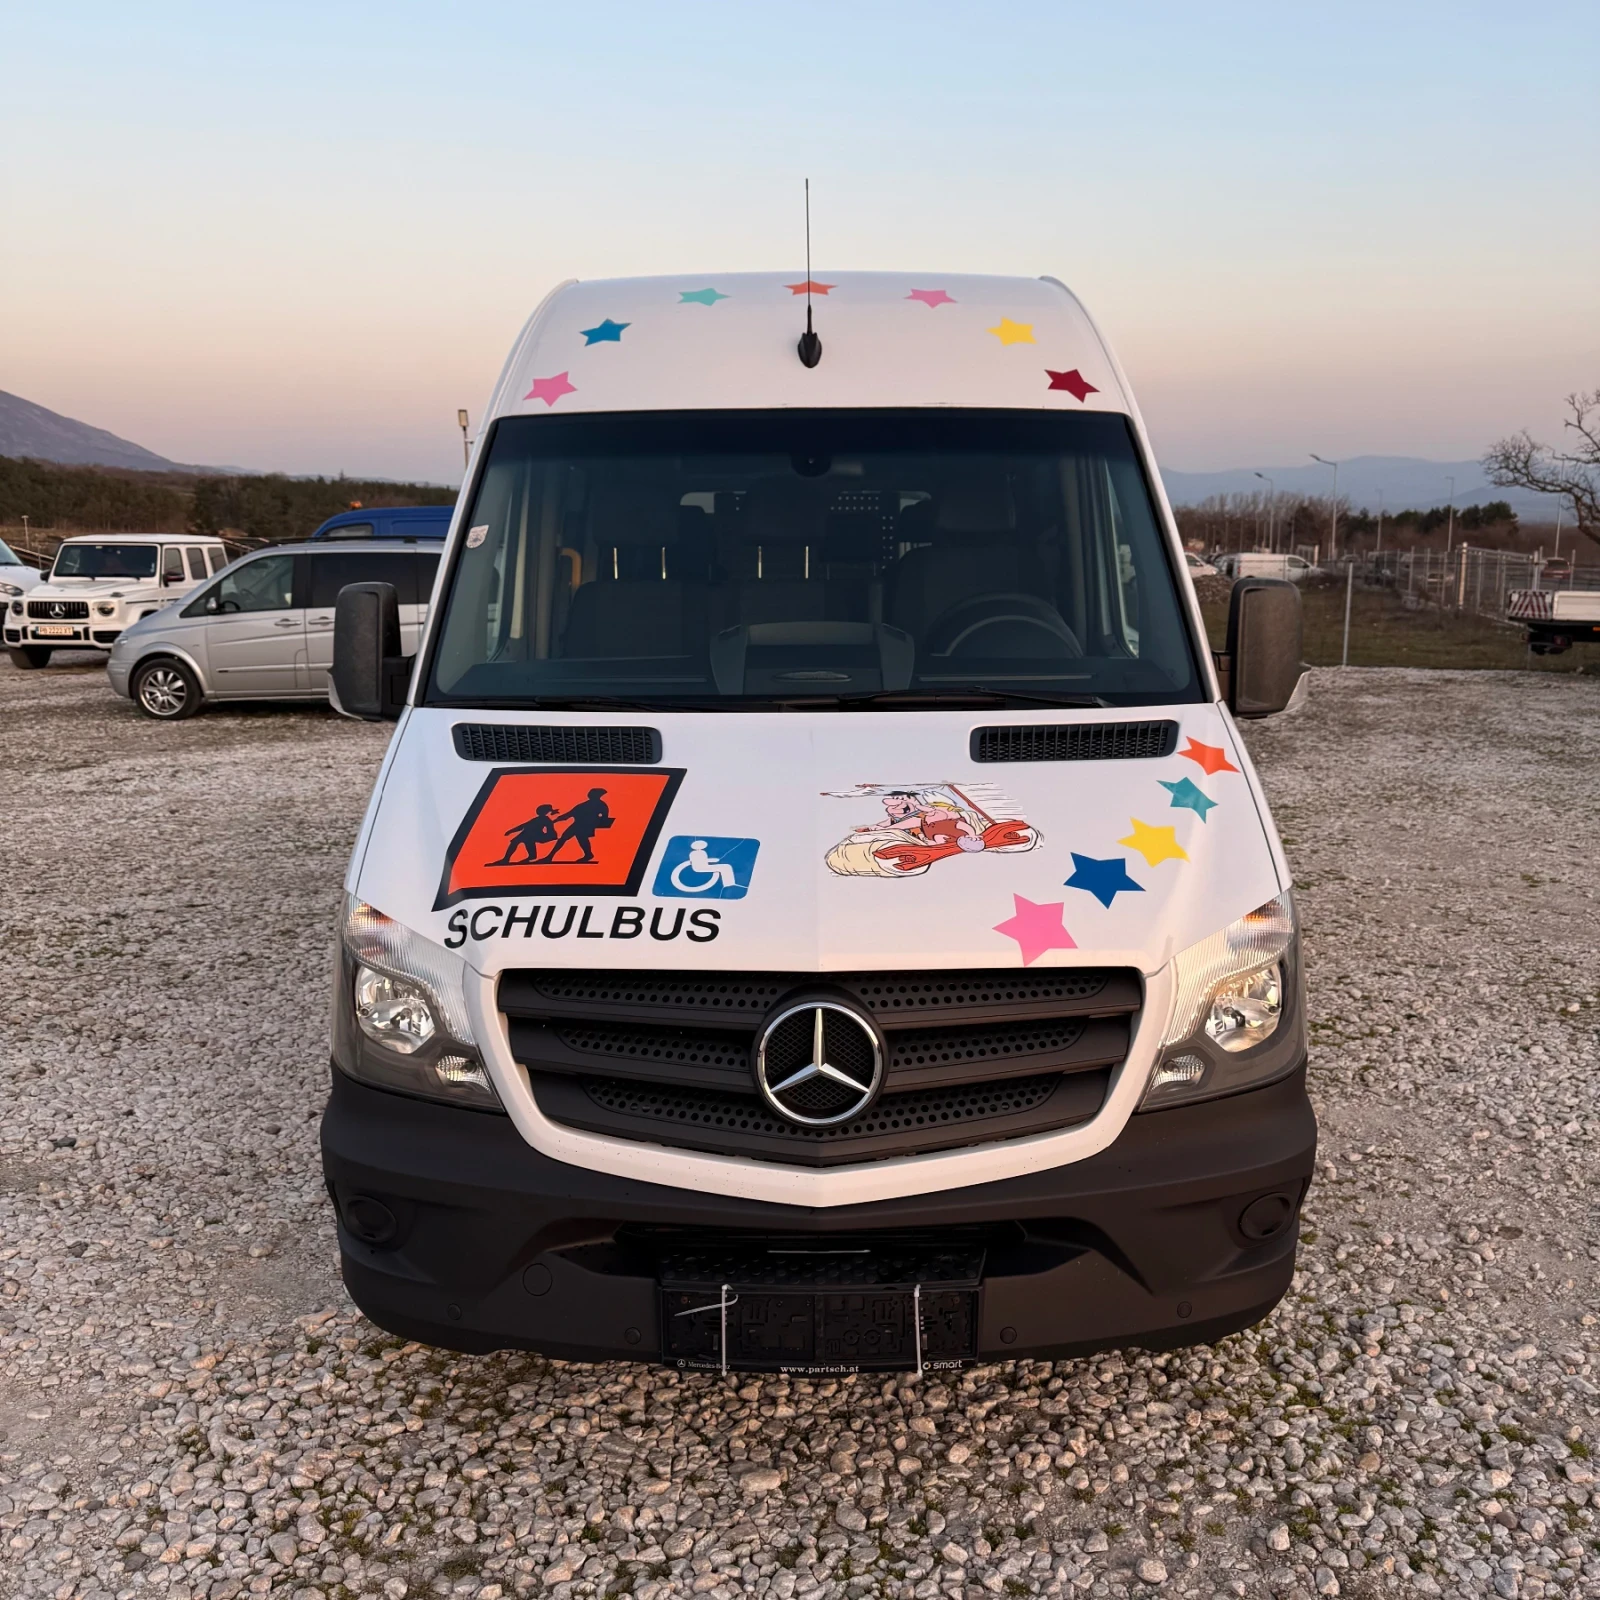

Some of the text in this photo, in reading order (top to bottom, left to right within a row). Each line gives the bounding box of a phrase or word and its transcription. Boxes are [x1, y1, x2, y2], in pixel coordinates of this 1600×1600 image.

[48, 626, 63, 634] 2222
[444, 905, 721, 948] SCHULBUS
[933, 1360, 962, 1369] smart
[780, 1365, 859, 1374] www.partsch.at
